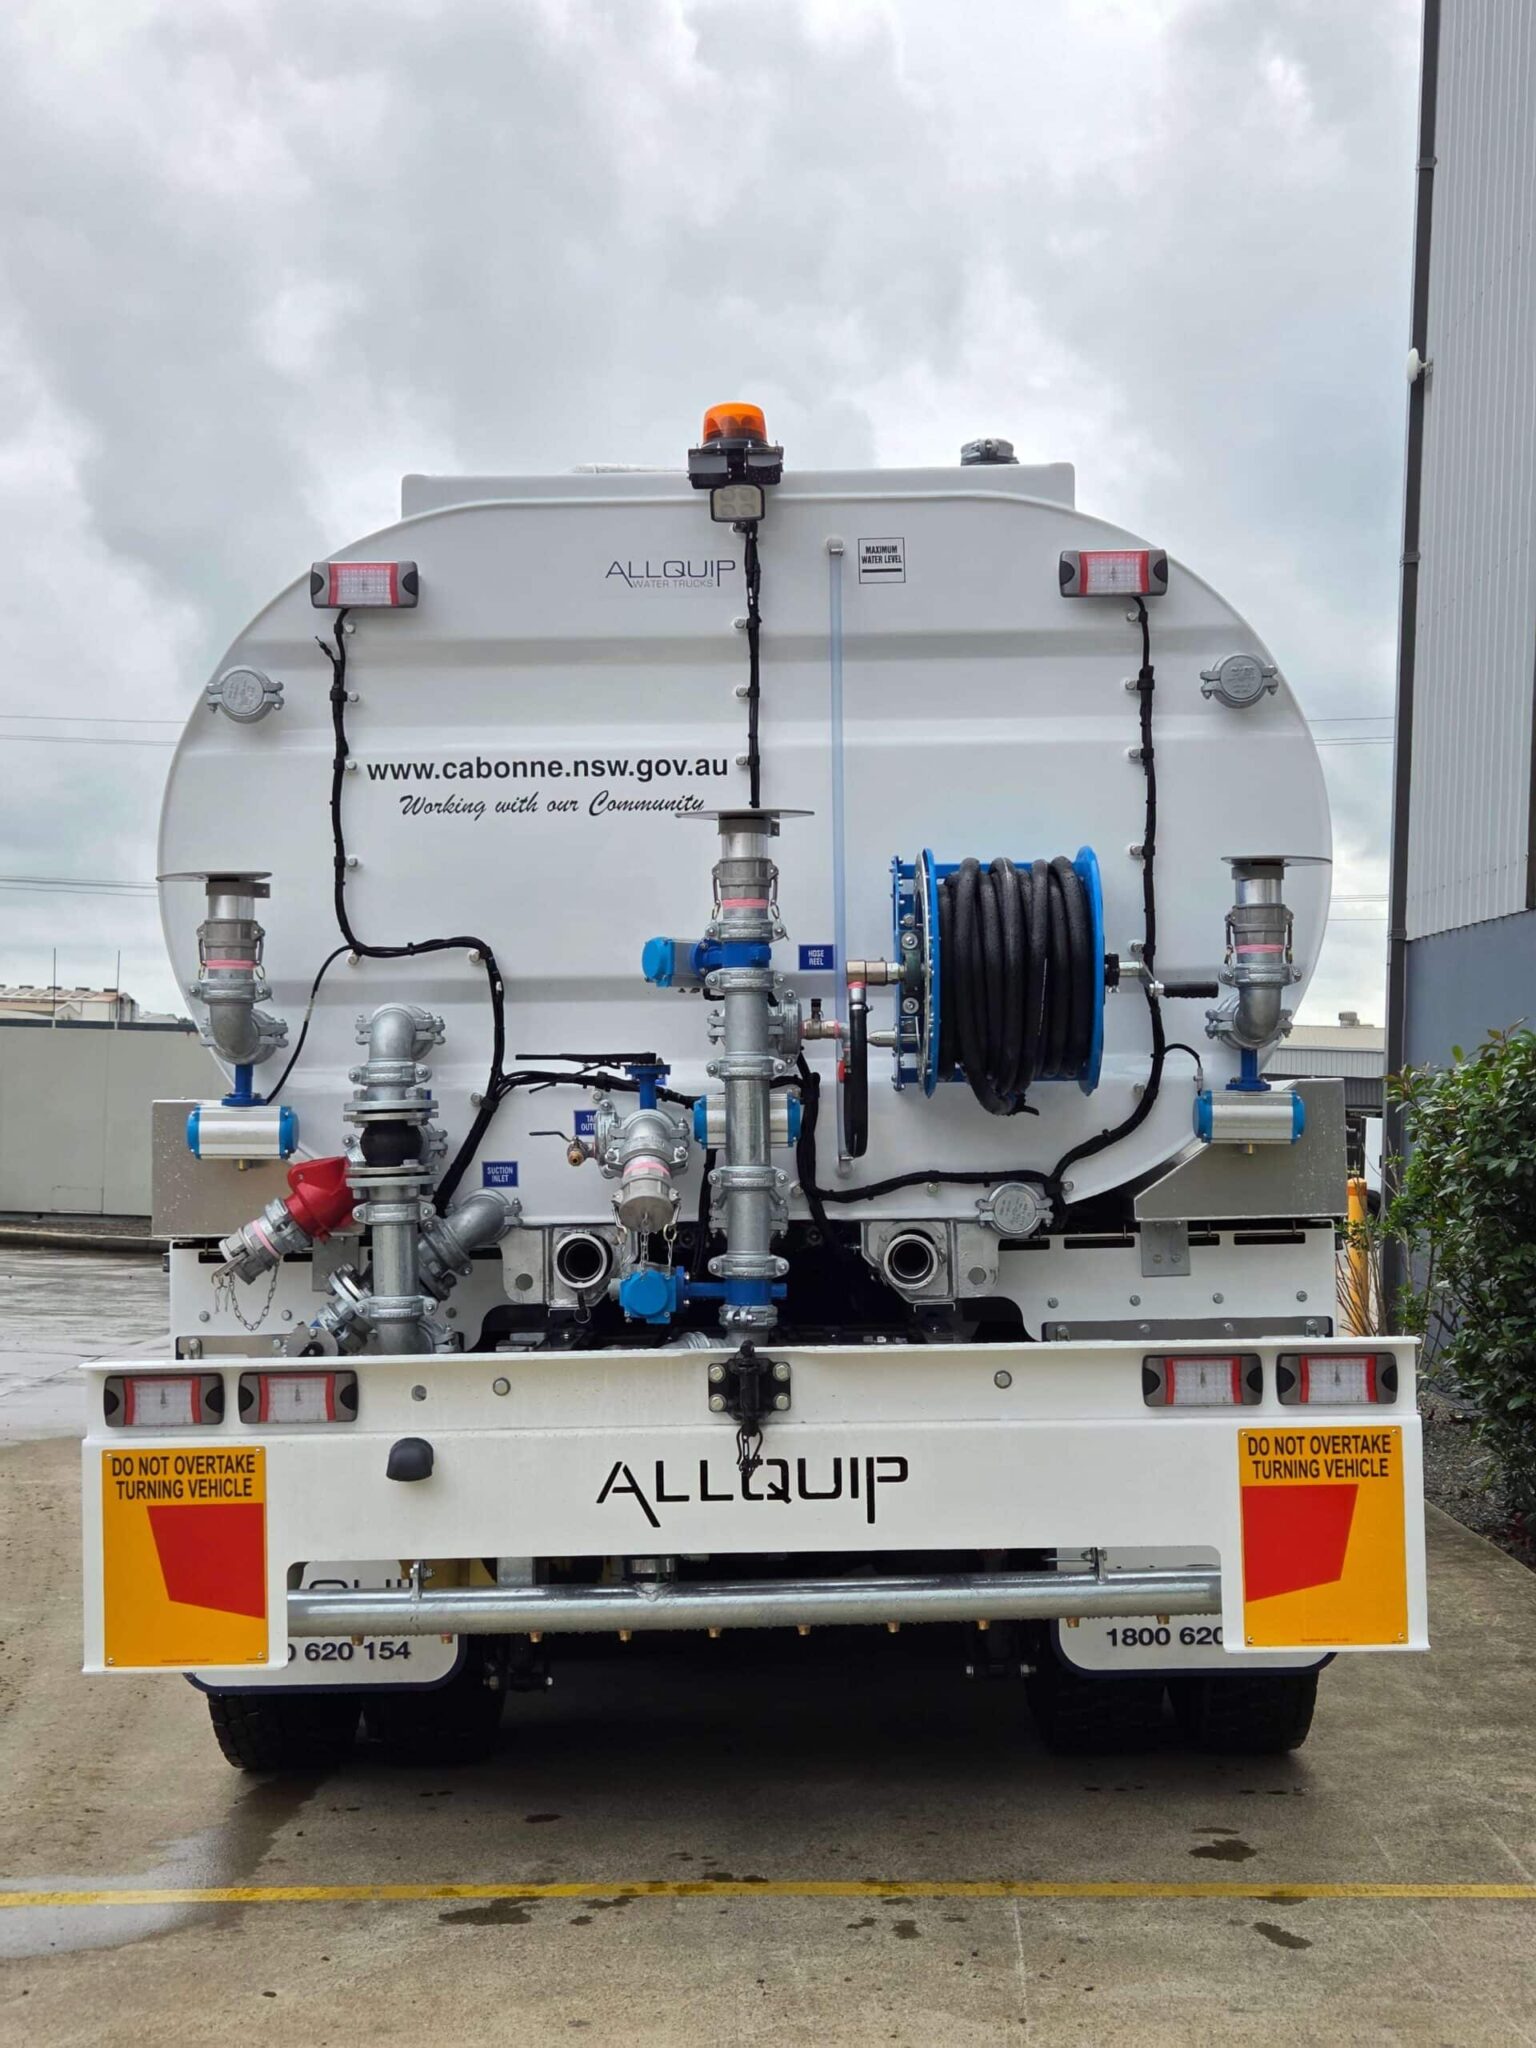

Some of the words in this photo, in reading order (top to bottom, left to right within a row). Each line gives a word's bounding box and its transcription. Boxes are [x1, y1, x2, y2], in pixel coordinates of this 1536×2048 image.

[861, 555, 883, 564] WATER
[884, 555, 902, 564] LEVEL
[865, 545, 898, 554] MAXIMUM
[605, 560, 736, 588] ALLQUIP
[632, 579, 669, 588] WATER
[673, 579, 713, 588] TRUCKS
[367, 756, 728, 782] www.cabonne.nsw.gov.au
[400, 794, 486, 821] Working
[495, 792, 540, 813] with
[546, 799, 579, 813] our
[589, 790, 705, 816] Community
[808, 949, 824, 958] HOSE
[487, 1166, 513, 1175] SUCTION
[491, 1174, 509, 1182] INLET
[1248, 1436, 1270, 1456] DO
[1274, 1436, 1305, 1455] NOT
[1310, 1434, 1391, 1454] OVERTAKE
[112, 1457, 134, 1476] DO
[139, 1456, 170, 1475] NOT
[174, 1454, 256, 1475] OVERTAKE
[1252, 1459, 1320, 1479] TURNING
[1324, 1458, 1389, 1478] VEHICLE
[116, 1479, 184, 1500] TURNING
[188, 1478, 252, 1498] VEHICLE
[596, 1456, 908, 1527] ALLQUIP
[1106, 1627, 1171, 1646] 1800
[304, 1641, 354, 1661] 620
[364, 1641, 411, 1660] 154
